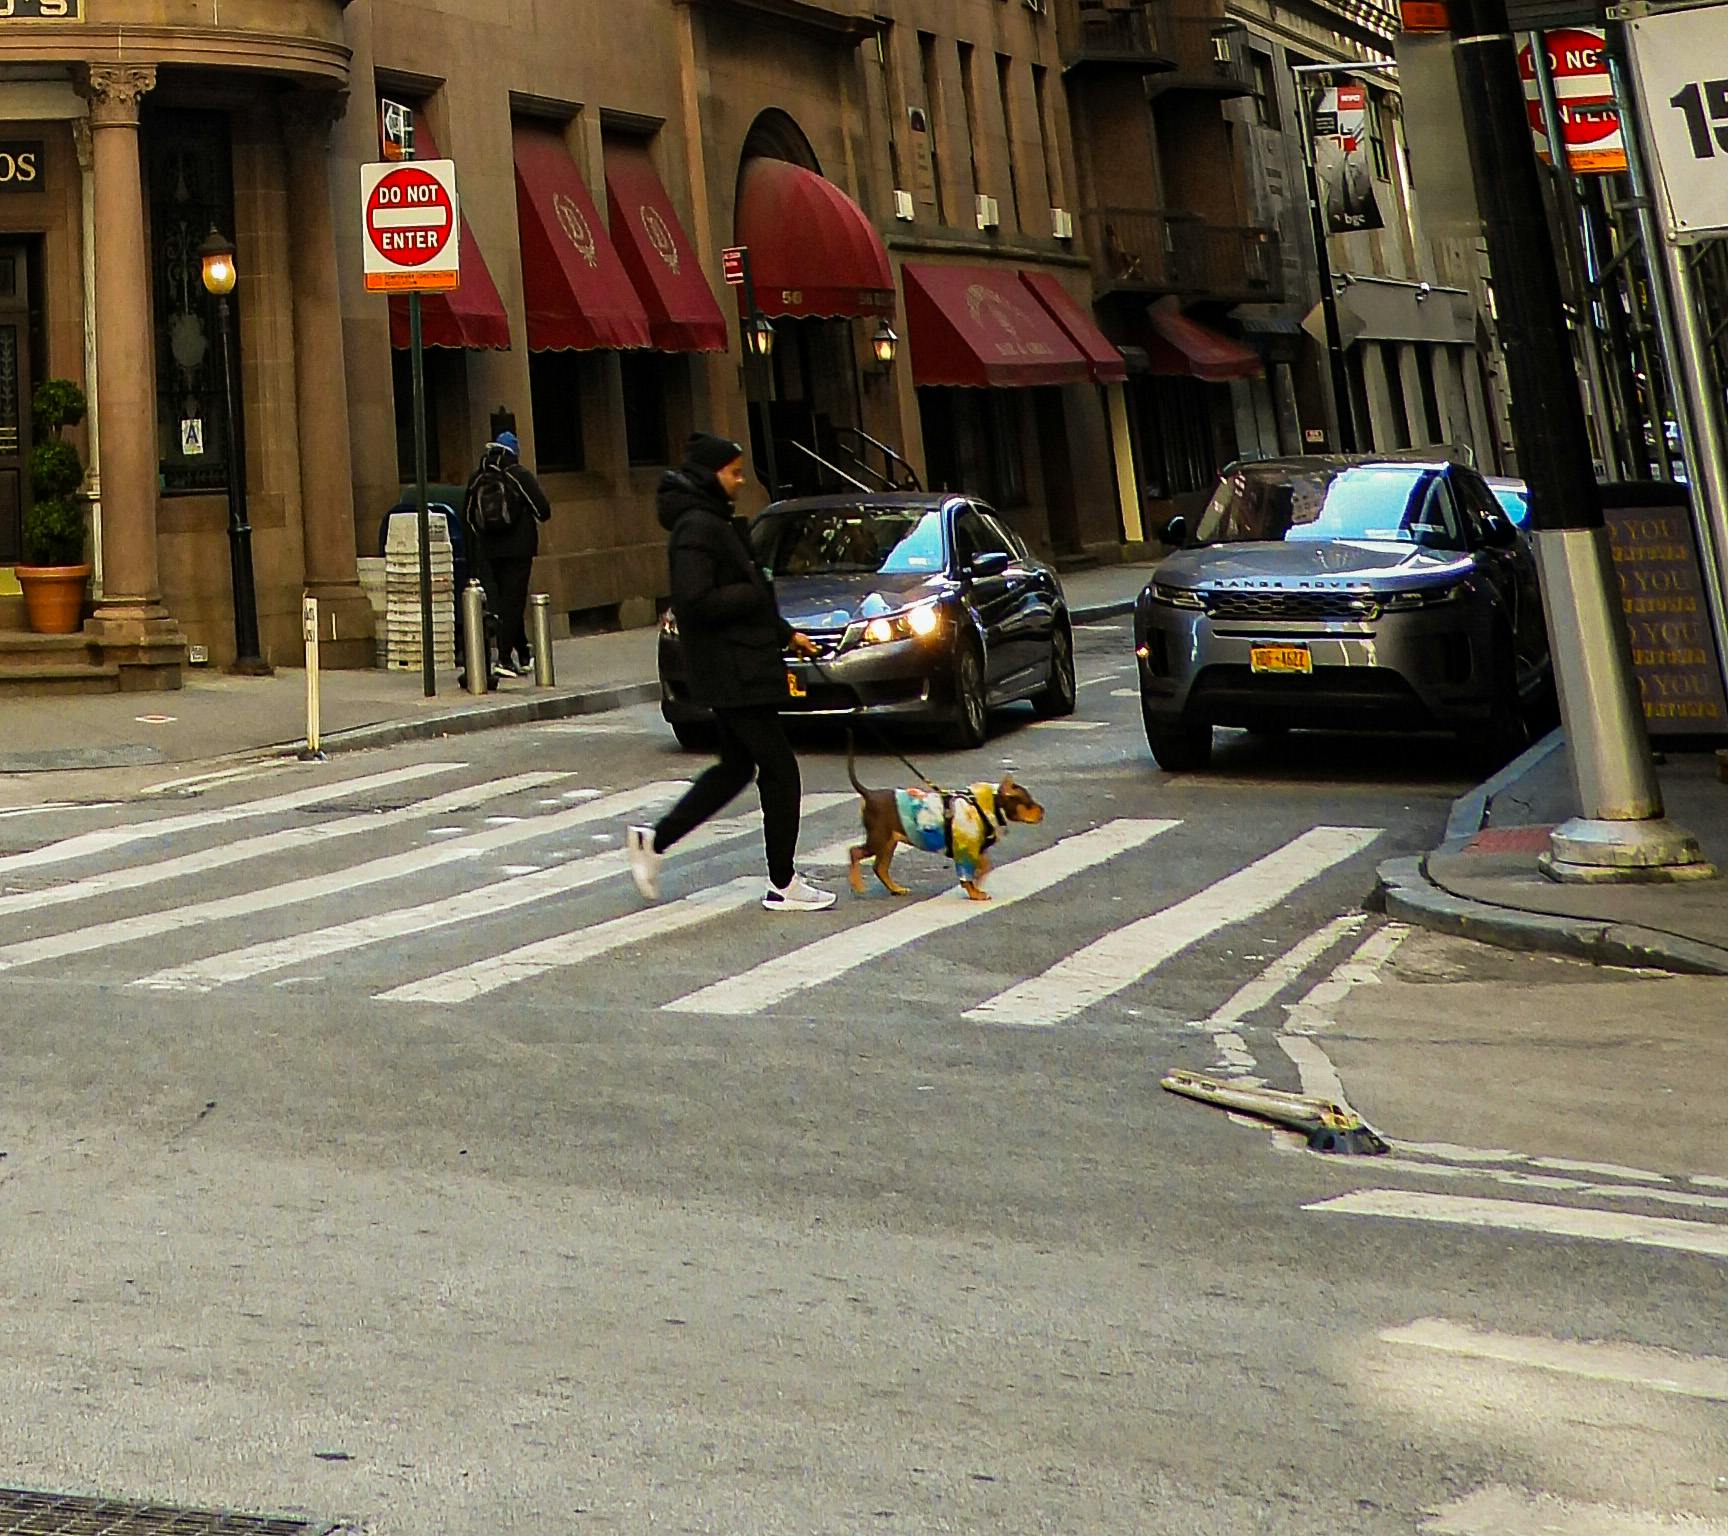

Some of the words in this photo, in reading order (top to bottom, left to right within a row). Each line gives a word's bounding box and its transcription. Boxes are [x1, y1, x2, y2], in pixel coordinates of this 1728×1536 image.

[379, 187, 401, 204] DO
[407, 185, 438, 203] NOT
[382, 231, 438, 250] ENTER
[1214, 580, 1283, 588] RANGE
